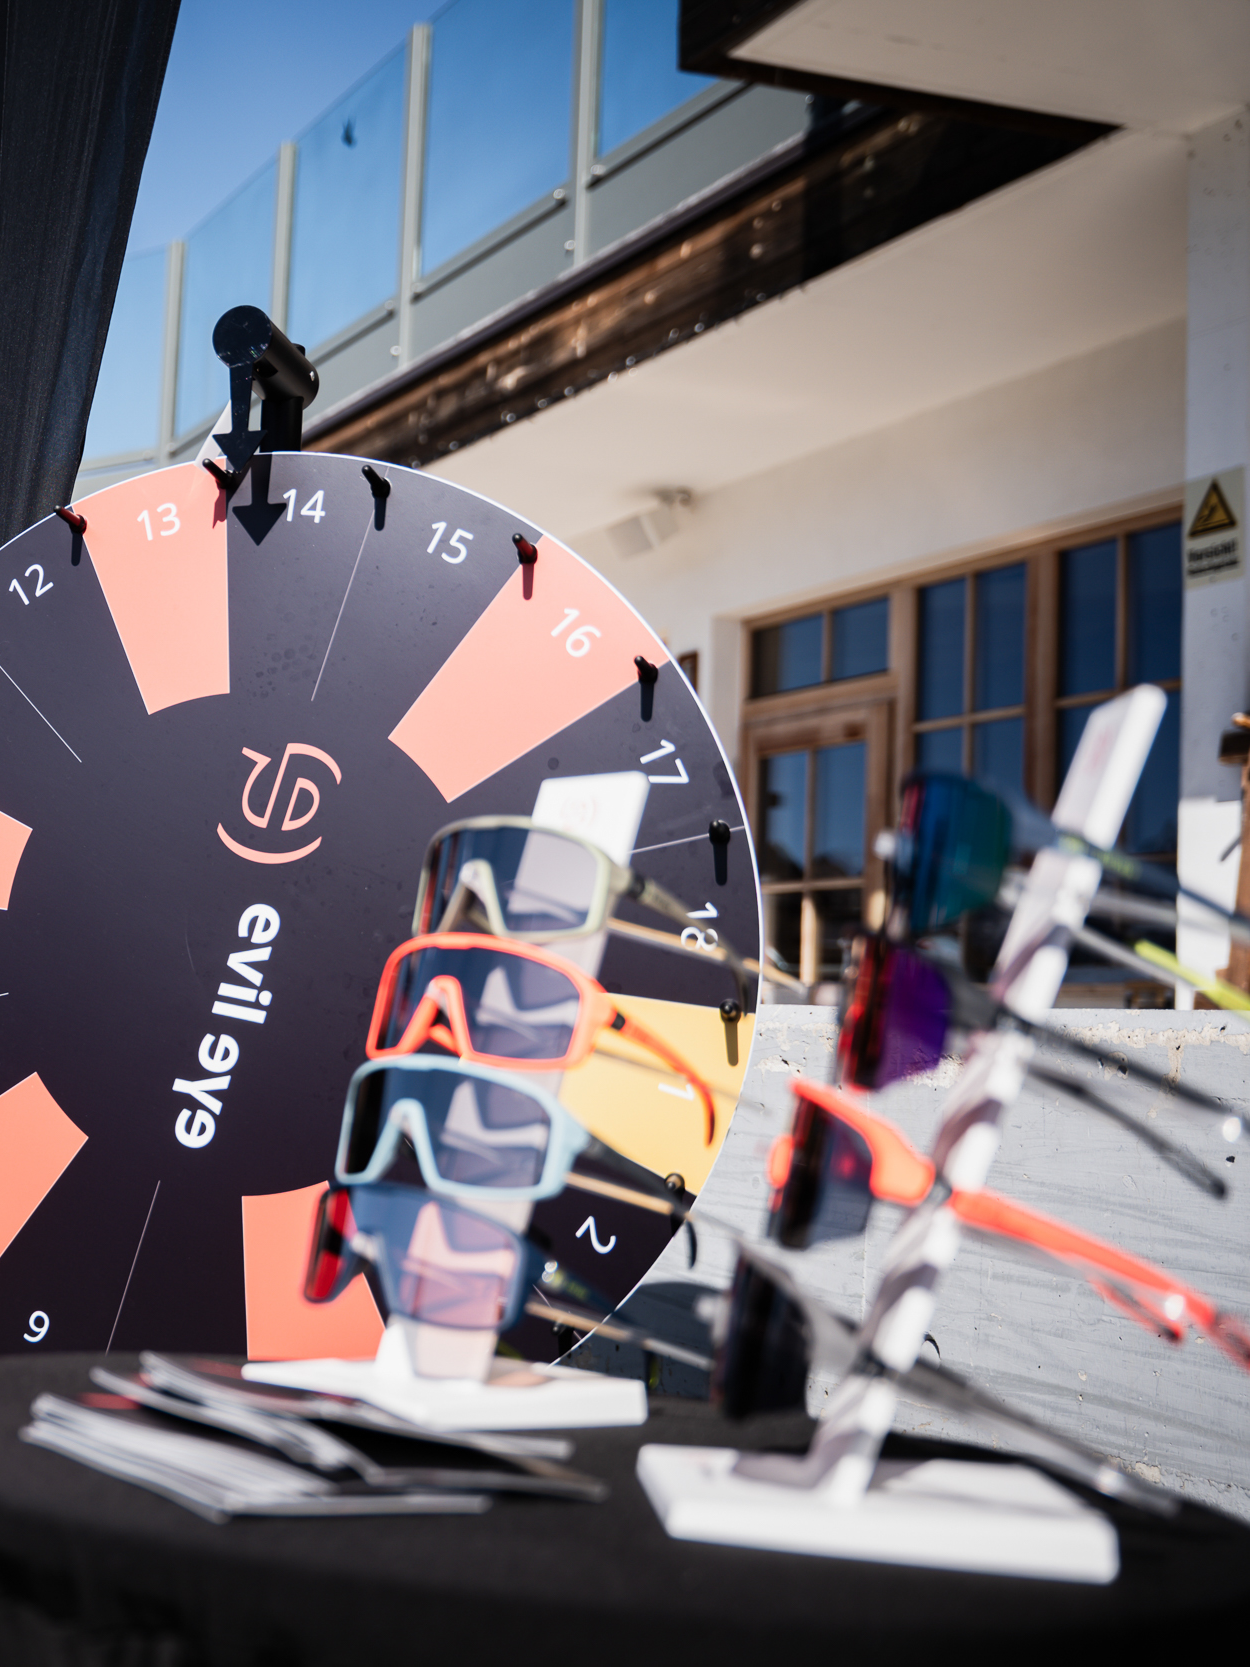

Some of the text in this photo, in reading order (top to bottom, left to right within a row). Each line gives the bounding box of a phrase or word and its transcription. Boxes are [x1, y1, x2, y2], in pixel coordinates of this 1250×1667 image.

[136, 502, 181, 541] 13
[282, 488, 326, 524] 14
[426, 521, 474, 565] 15
[8, 563, 54, 606] 12
[550, 608, 602, 658] 16
[639, 738, 690, 785] 17
[680, 901, 719, 951] 18
[211, 902, 281, 1025] evil
[657, 1082, 696, 1101] 1
[575, 1215, 617, 1255] 2
[23, 1310, 50, 1343] 6
